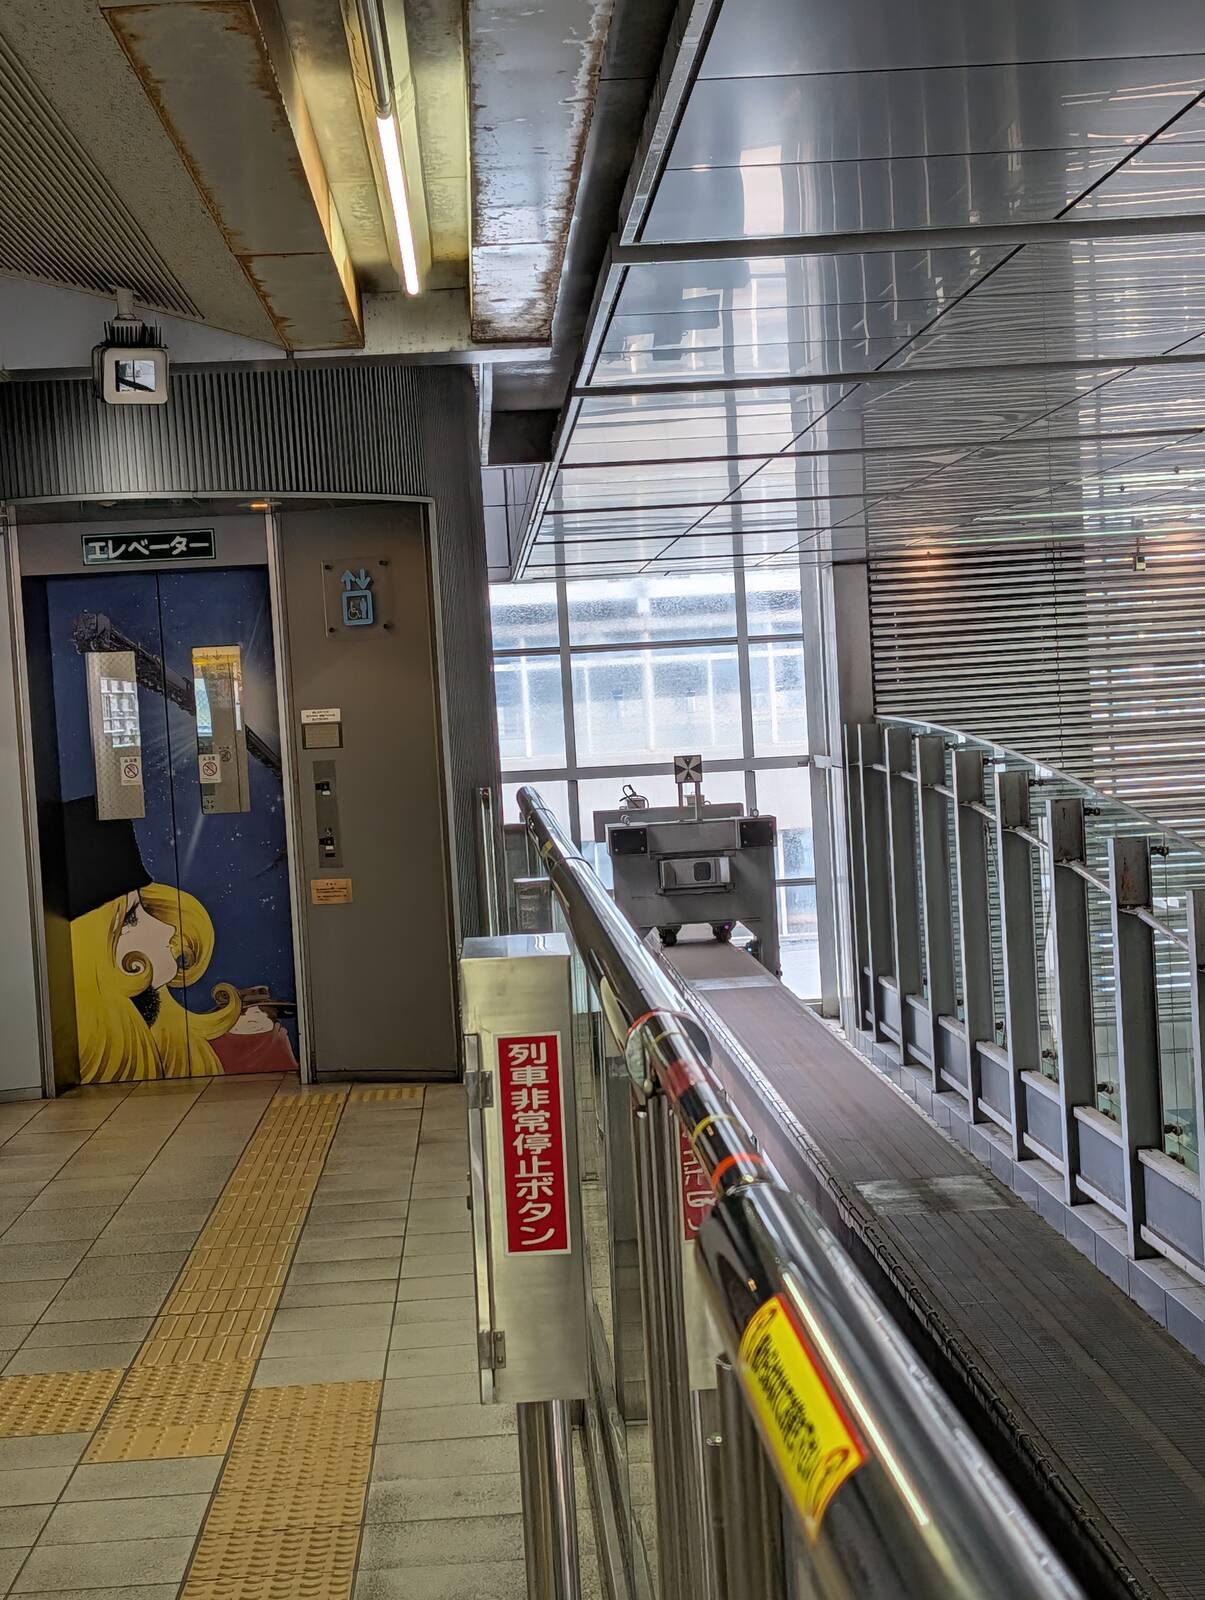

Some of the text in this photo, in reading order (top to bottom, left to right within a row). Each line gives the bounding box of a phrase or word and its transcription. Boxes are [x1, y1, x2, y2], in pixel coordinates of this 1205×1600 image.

[87, 535, 210, 559] エレベーター
[508, 1042, 556, 1246] 列車非常停止ボタン
